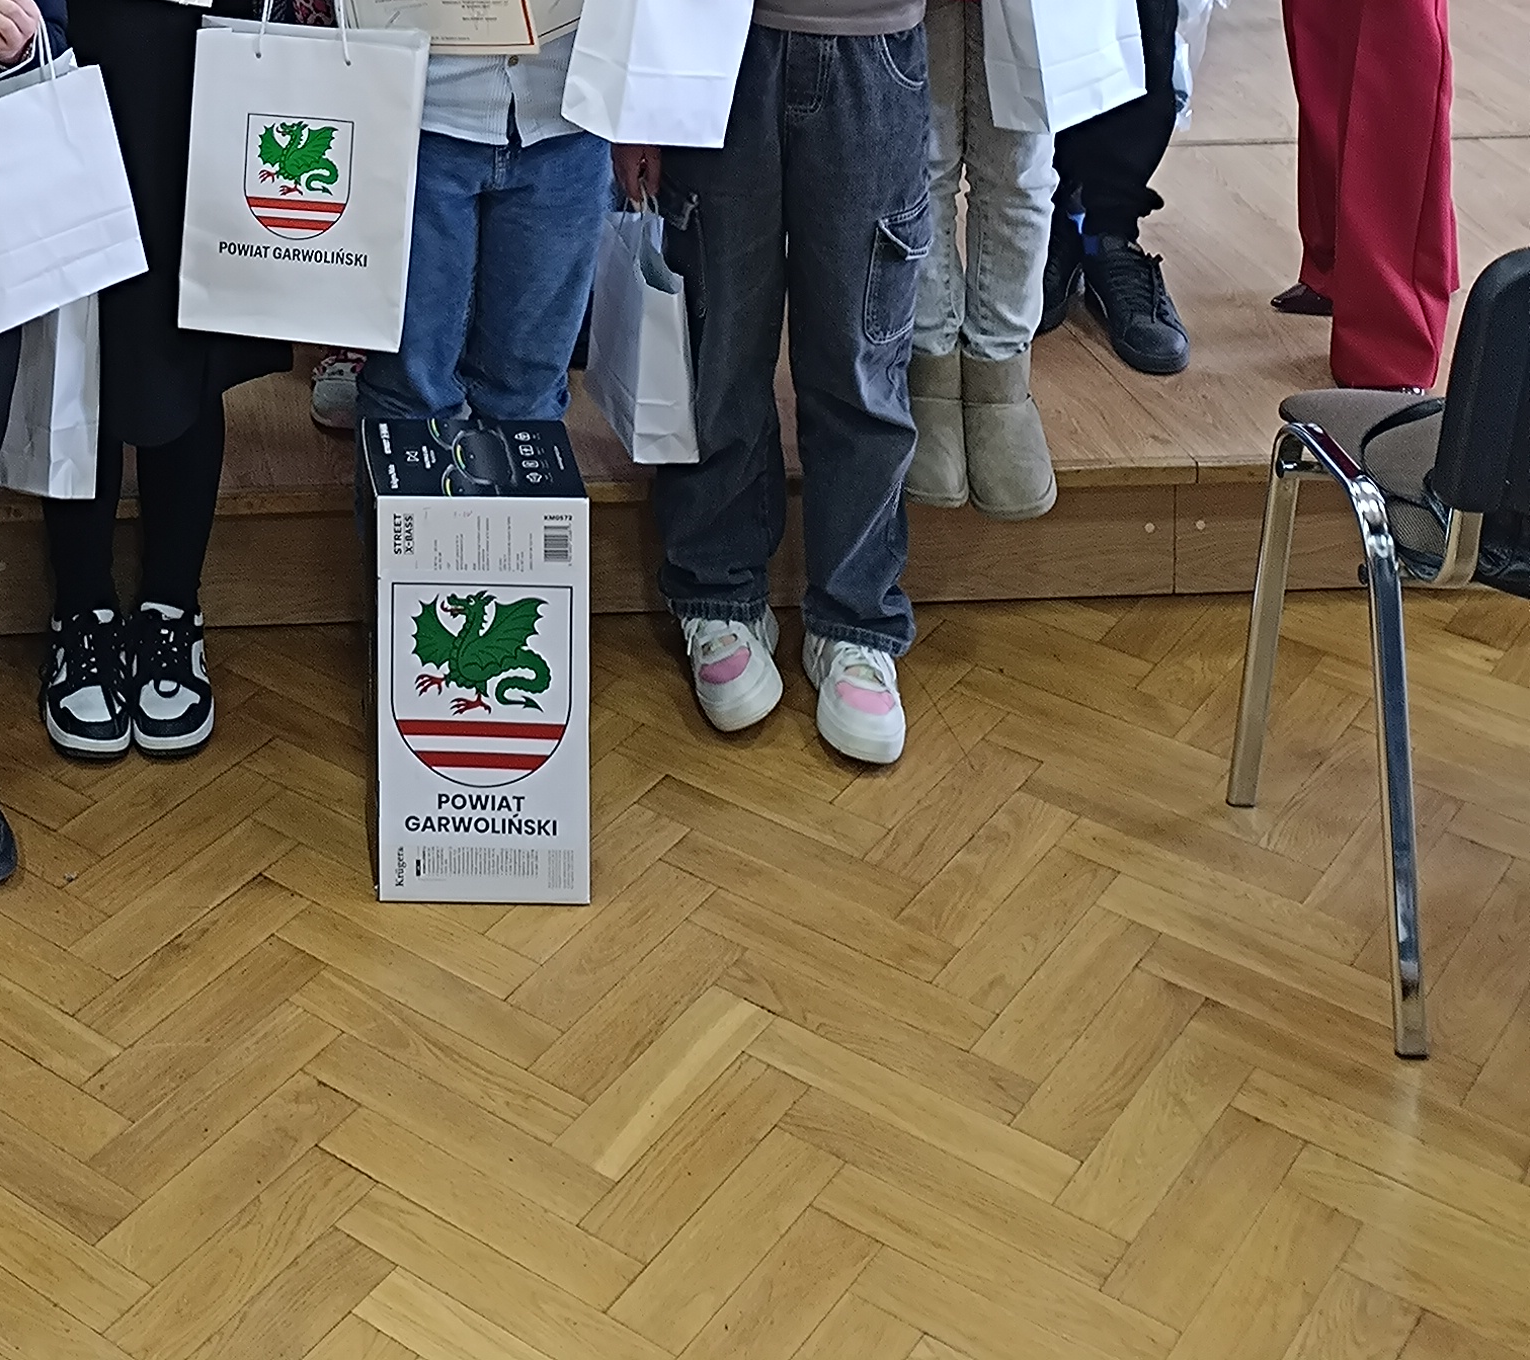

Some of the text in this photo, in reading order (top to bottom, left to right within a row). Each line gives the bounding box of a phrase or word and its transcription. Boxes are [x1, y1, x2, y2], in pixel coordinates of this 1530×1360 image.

[219, 241, 368, 268] POWIAT GARWOLIŃSKI
[393, 513, 402, 555] STREET
[437, 793, 525, 812] POWIAT
[405, 813, 558, 836] GARWOLIŃSKI
